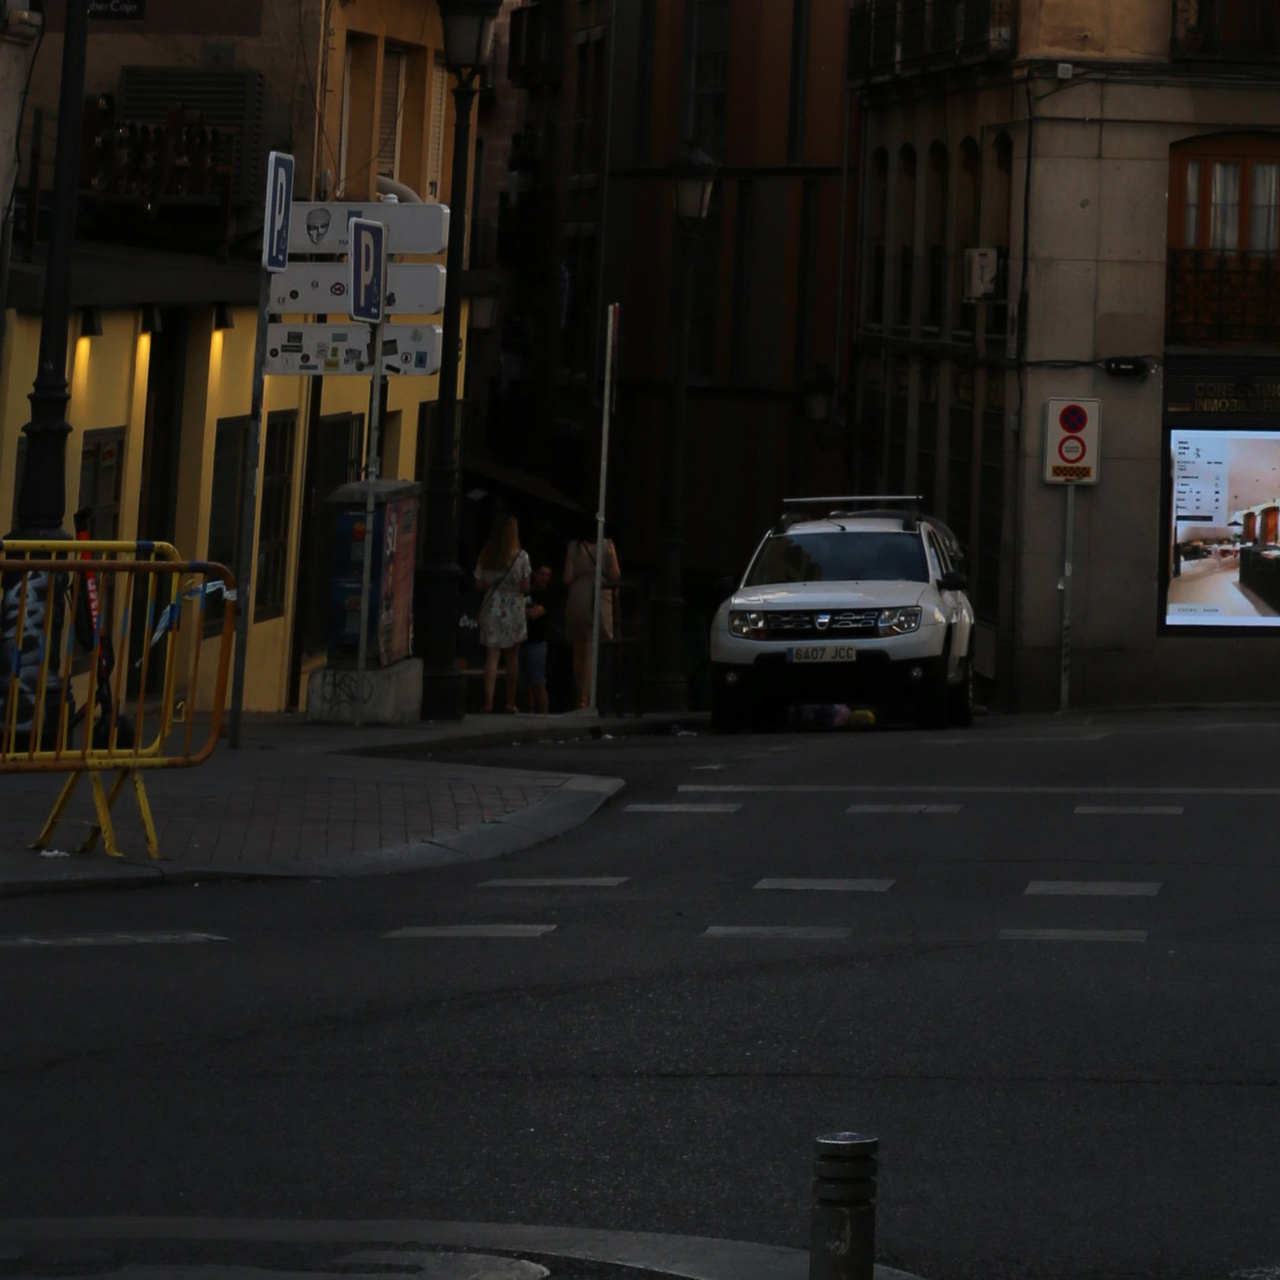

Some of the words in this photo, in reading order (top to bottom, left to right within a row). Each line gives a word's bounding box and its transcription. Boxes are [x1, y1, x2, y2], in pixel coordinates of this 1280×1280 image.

[272, 167, 287, 257] P
[359, 230, 375, 307] P
[794, 647, 826, 661] 6407
[831, 646, 854, 660] JCC
